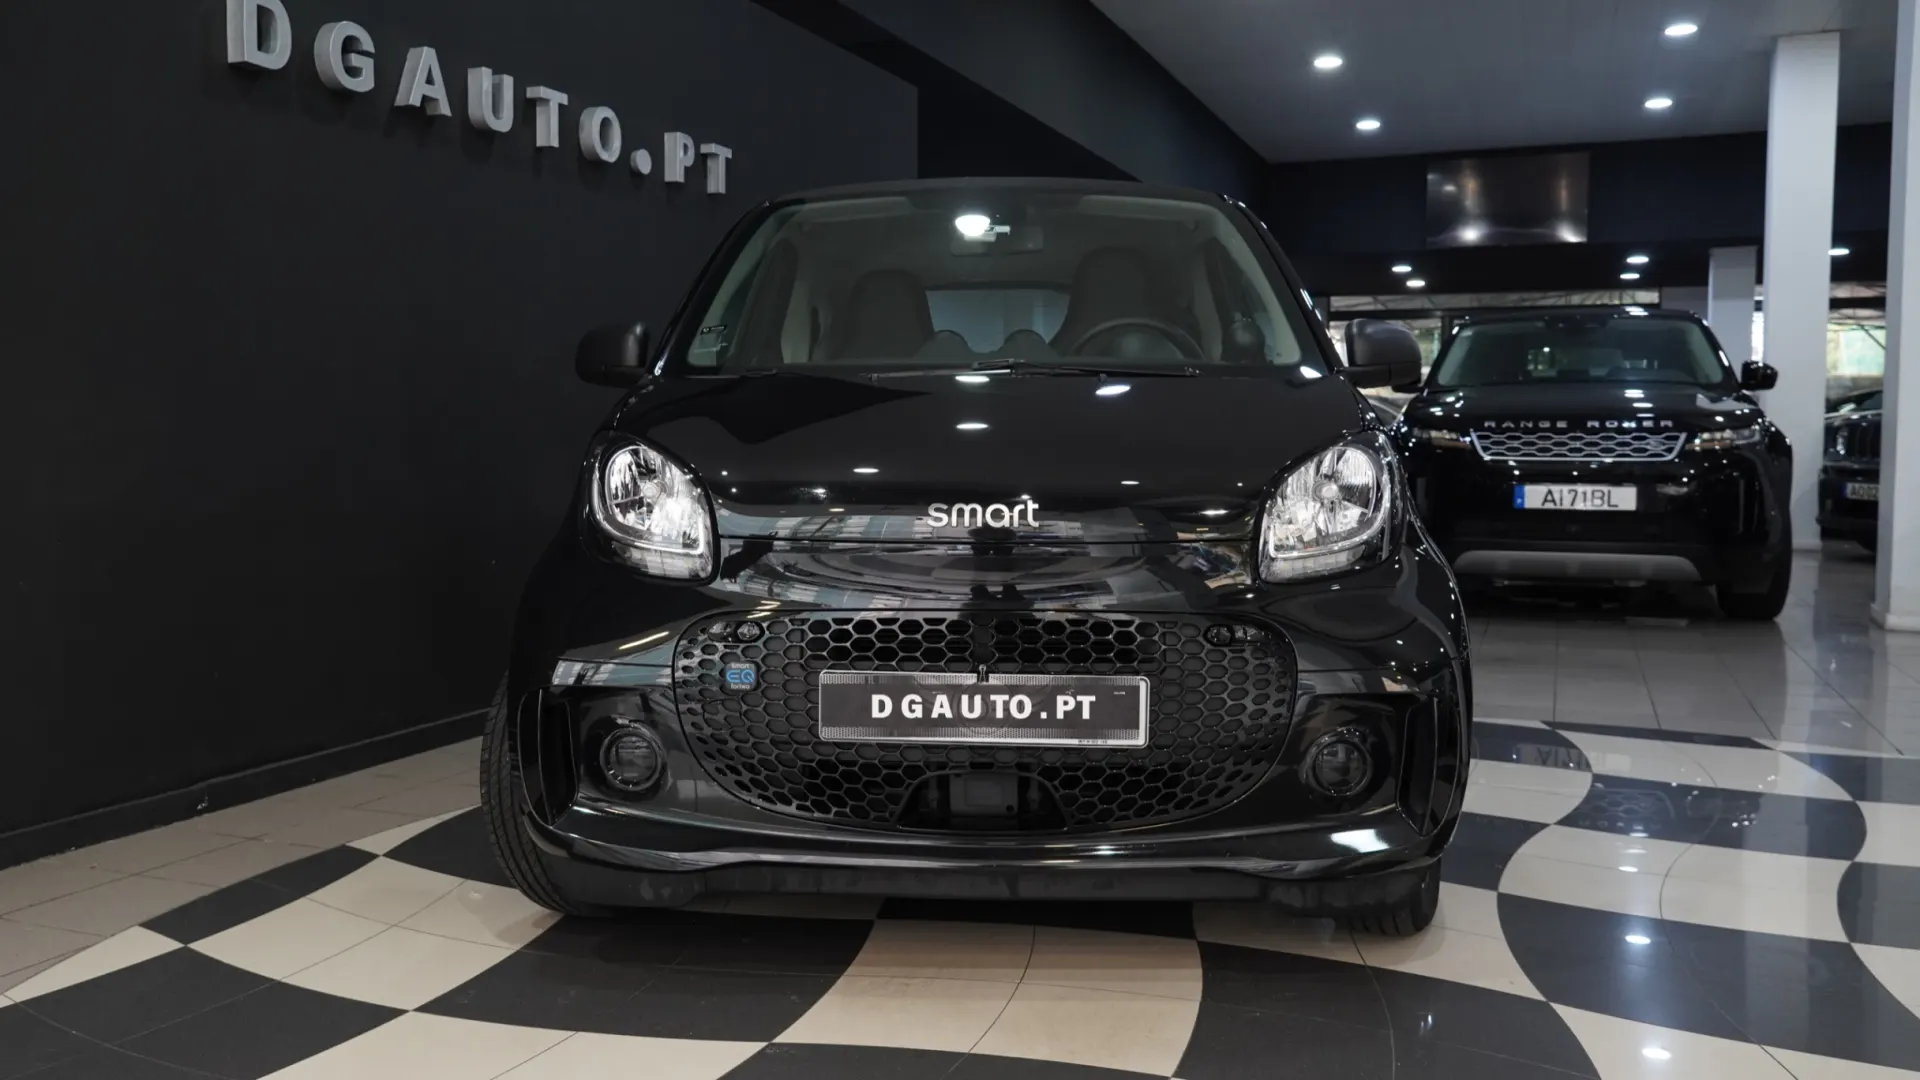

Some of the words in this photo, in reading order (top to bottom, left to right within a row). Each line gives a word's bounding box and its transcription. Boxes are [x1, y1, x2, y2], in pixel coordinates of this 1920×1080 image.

[226, 0, 732, 194] DGAUTO.PT
[1484, 420, 1568, 428] RANGE
[927, 499, 1039, 528] smart
[726, 669, 755, 683] EQ
[871, 694, 1096, 720] DGAUTO.PT
